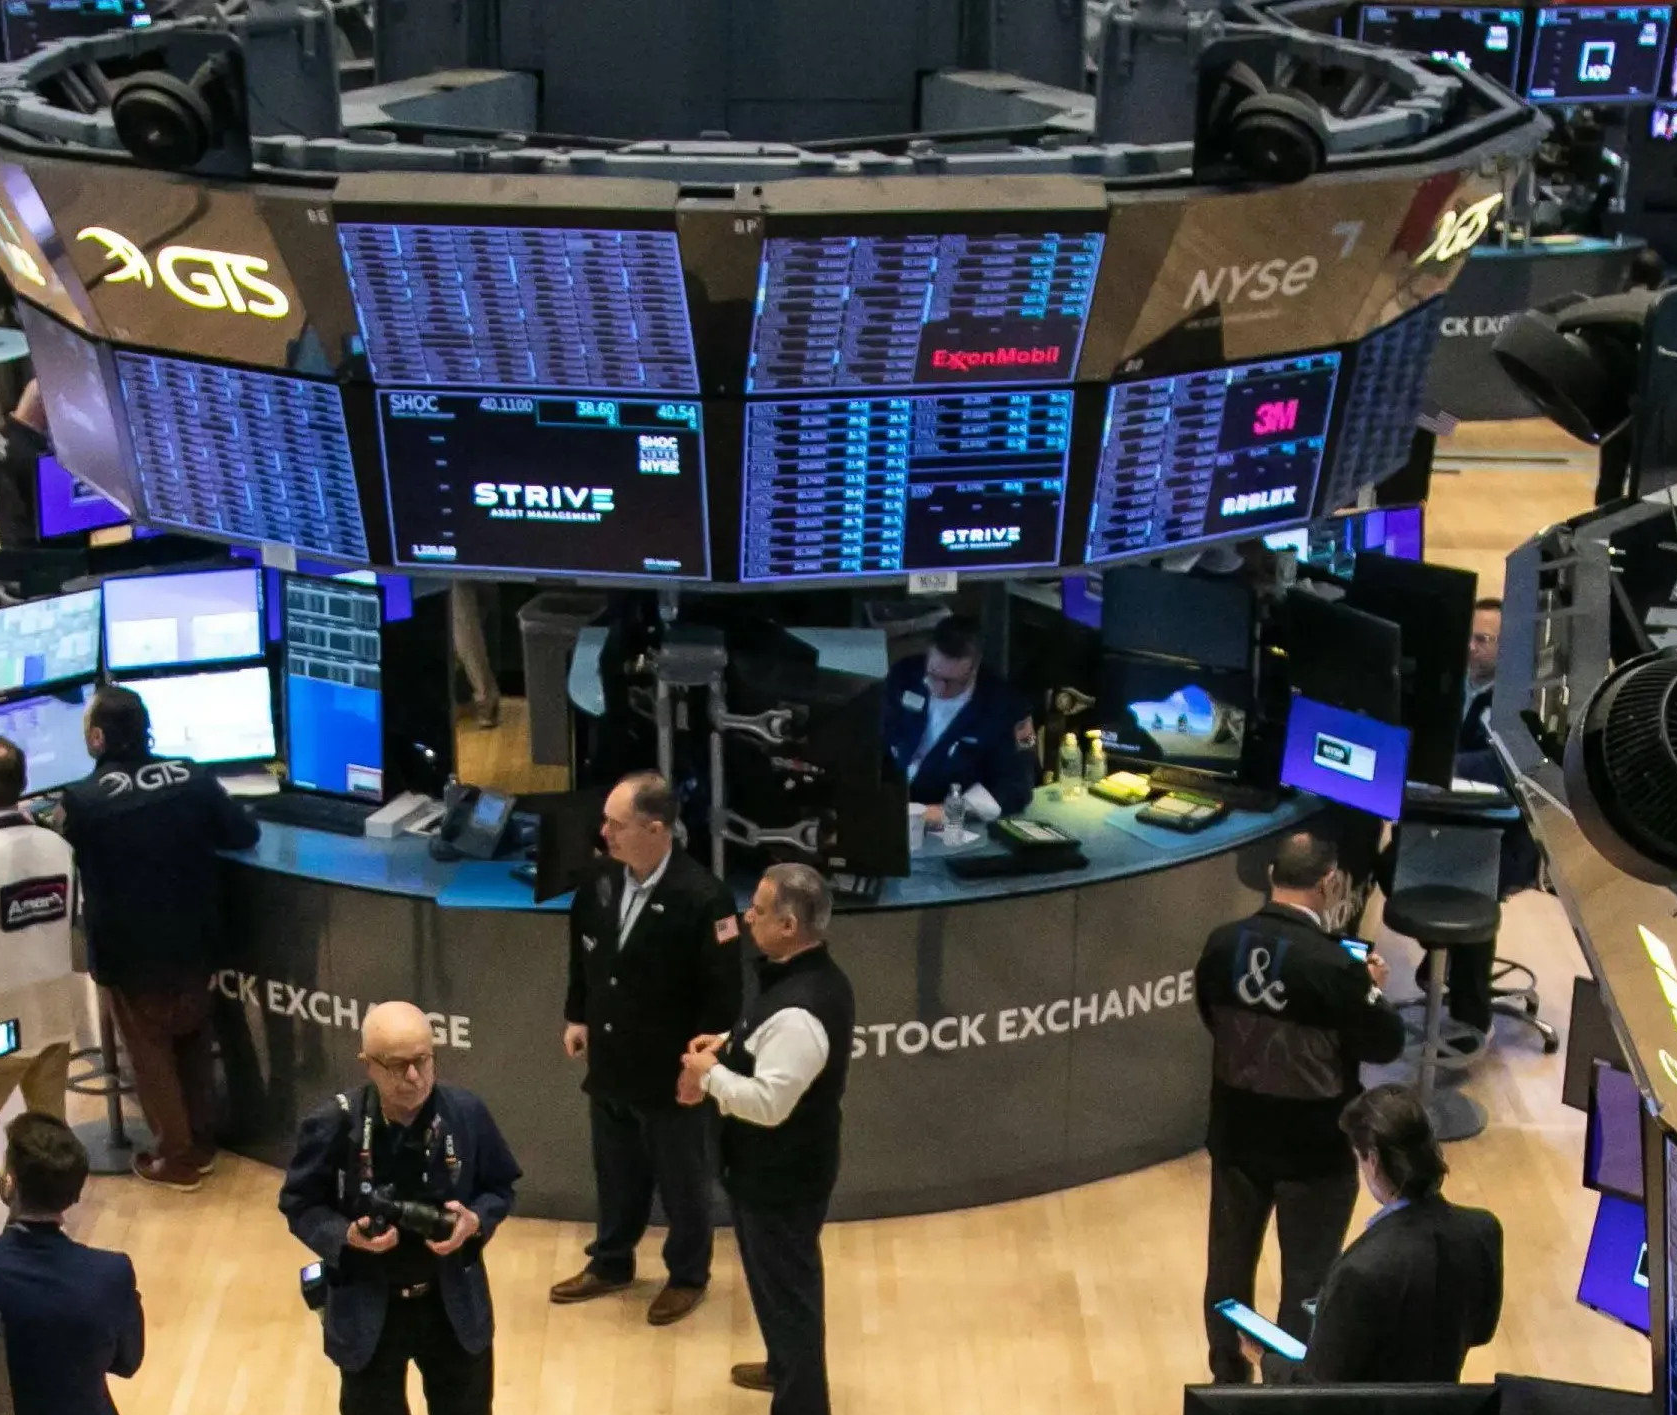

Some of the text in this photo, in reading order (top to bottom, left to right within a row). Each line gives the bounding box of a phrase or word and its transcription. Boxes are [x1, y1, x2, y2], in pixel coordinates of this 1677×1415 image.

[157, 245, 288, 318] GTS
[932, 346, 1059, 373] ExxonMobil
[390, 394, 439, 412] SHOC
[1253, 399, 1299, 435] 3M
[474, 483, 615, 511] STRIVE
[941, 526, 1020, 545] STRIVE
[136, 759, 191, 792] GTS
[266, 979, 472, 1050] EXCHGE
[850, 970, 1197, 1061] STOCK EXCHANGE
